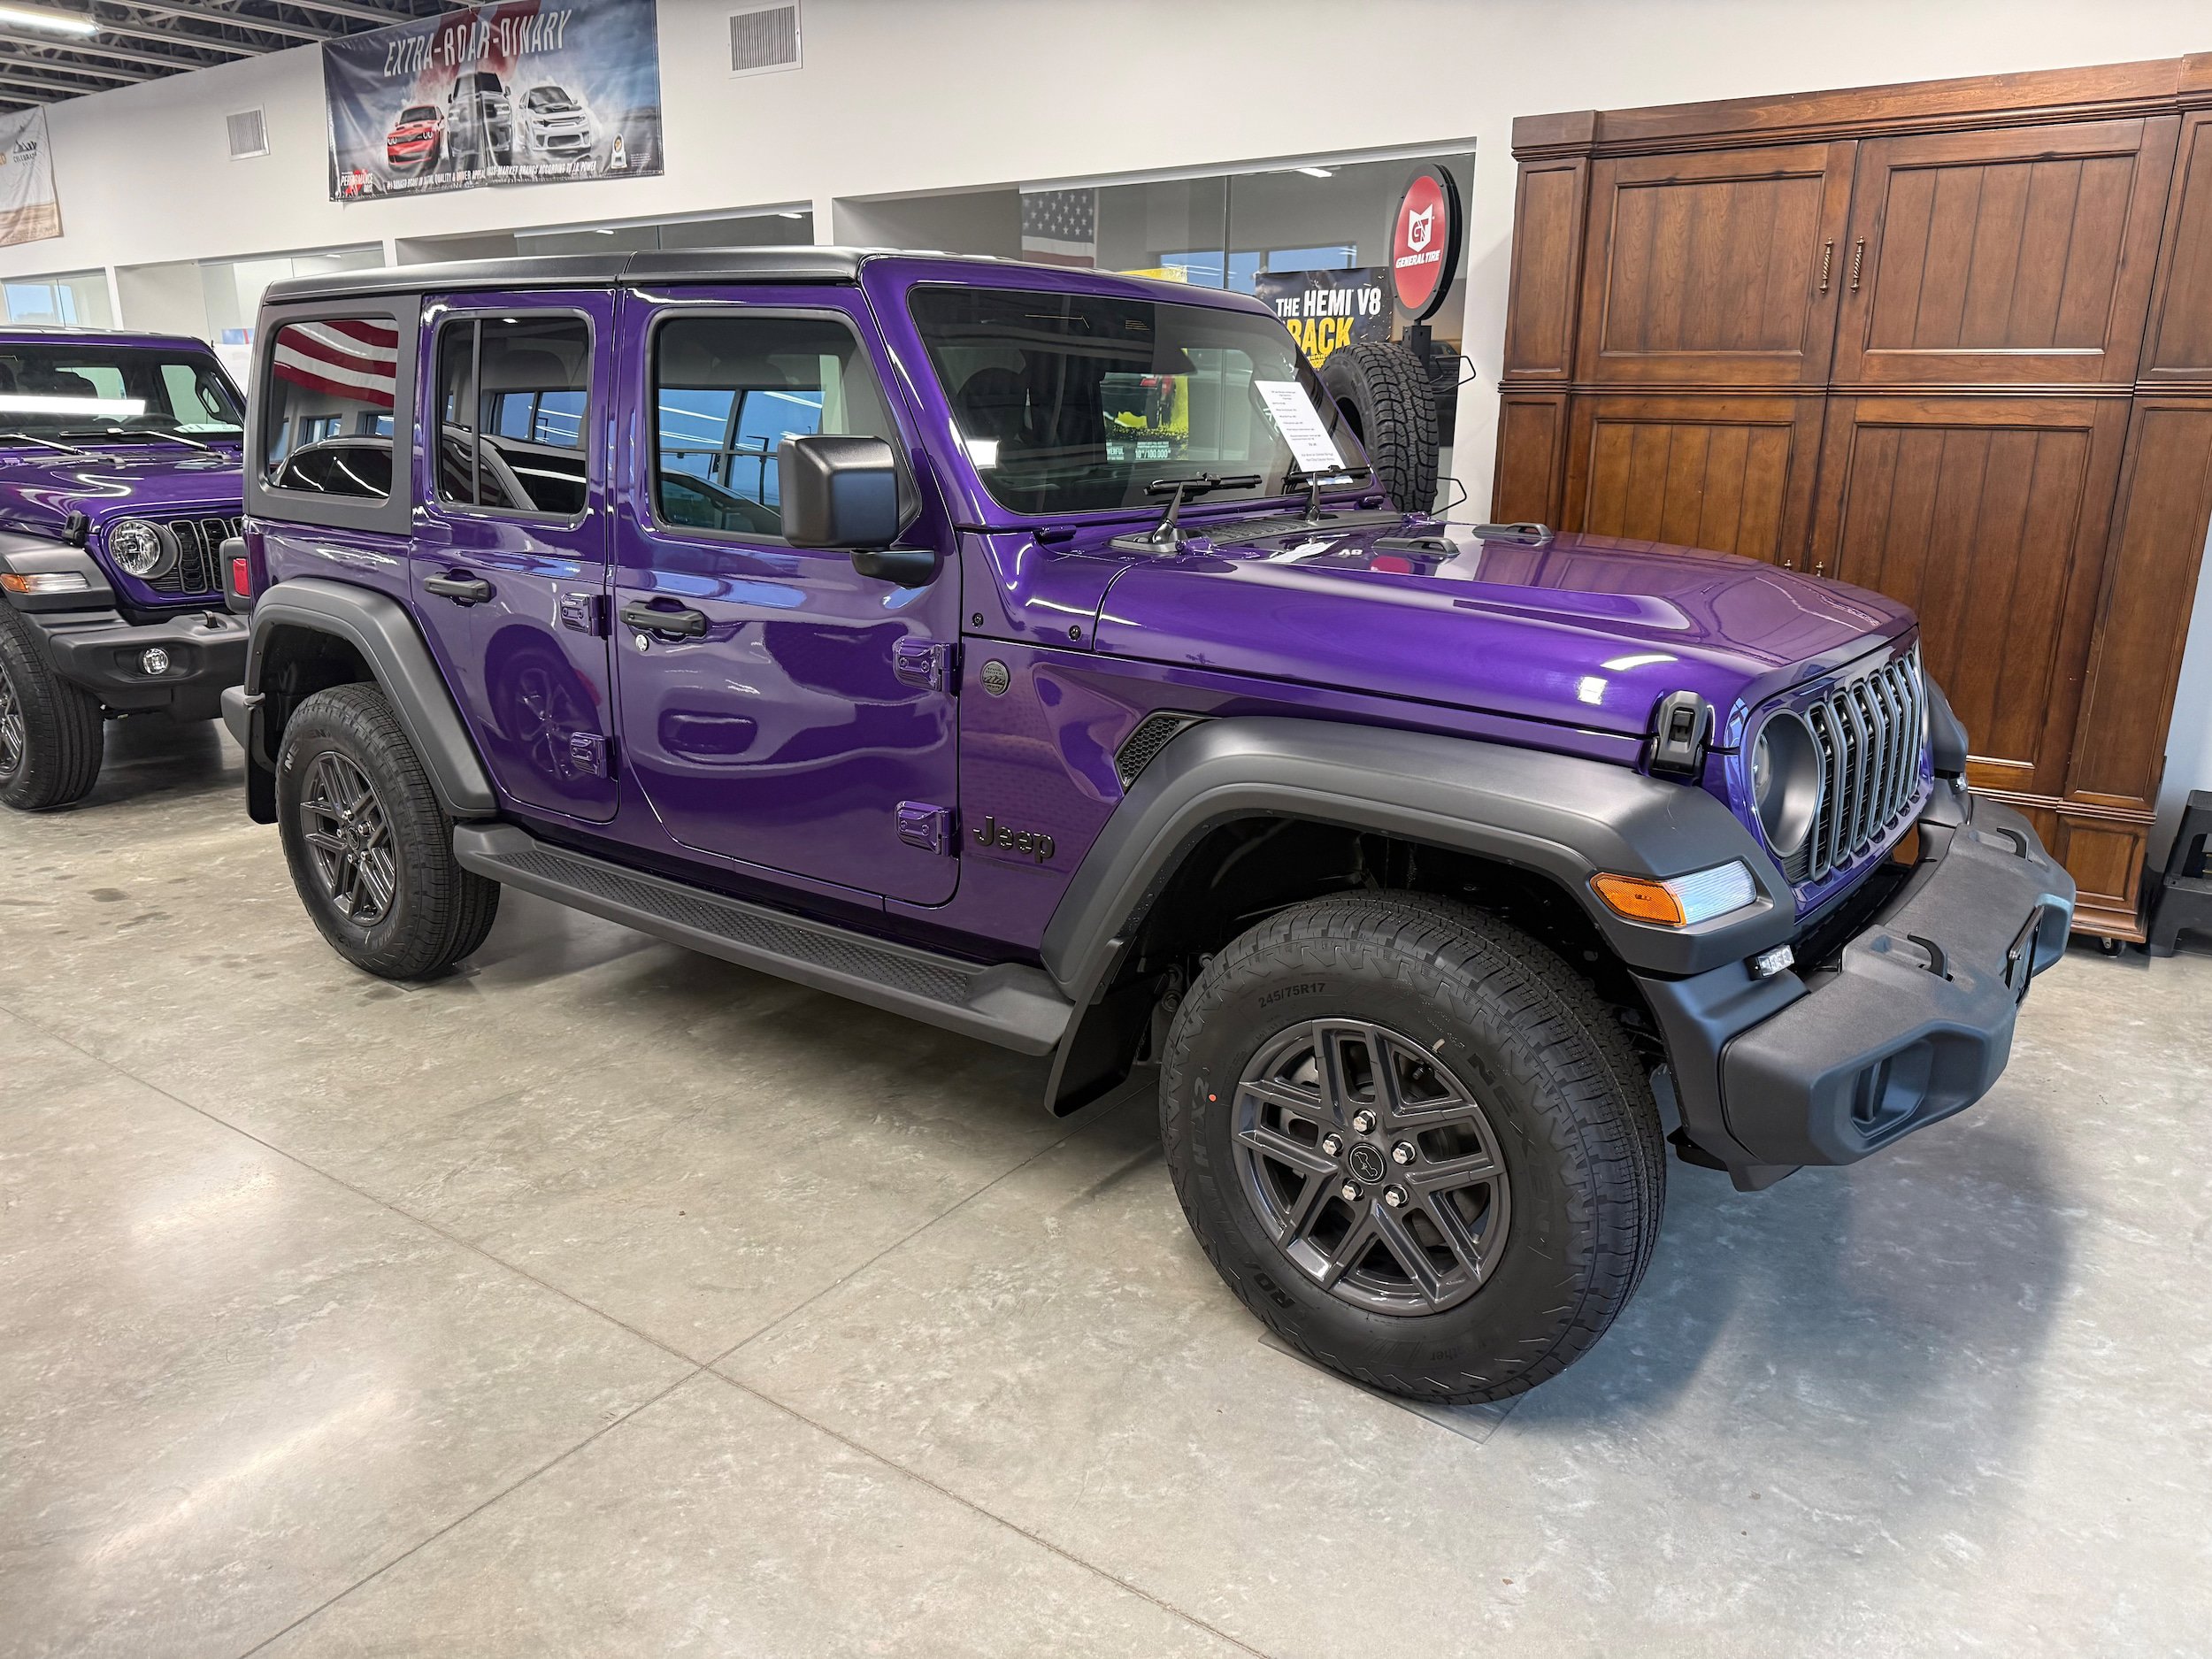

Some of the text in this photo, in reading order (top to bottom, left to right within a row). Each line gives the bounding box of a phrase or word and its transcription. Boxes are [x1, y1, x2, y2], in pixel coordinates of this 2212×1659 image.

[384, 10, 572, 77] EXTRA-ROAR-DINARY
[434, 173, 452, 185] QUALITY
[539, 163, 565, 174] ACCORDING
[580, 160, 597, 172] POWER
[1395, 250, 1440, 268] GENERAL TIRE
[1276, 298, 1301, 318] THE
[1357, 288, 1382, 316] V8
[972, 815, 1055, 864] Jeep
[1258, 982, 1326, 1009] 245/75R17
